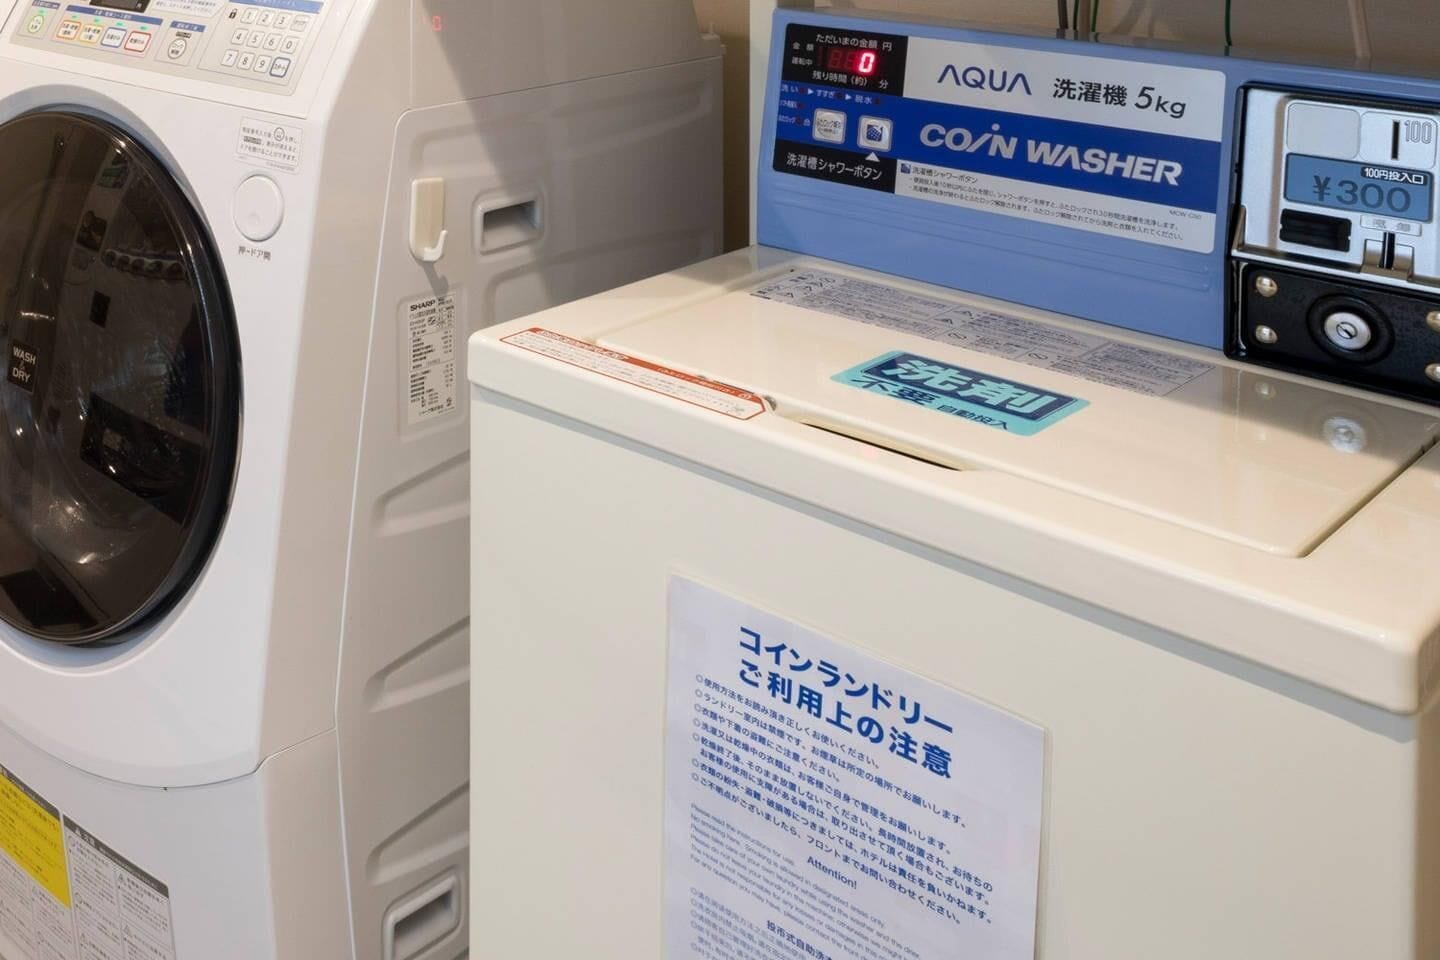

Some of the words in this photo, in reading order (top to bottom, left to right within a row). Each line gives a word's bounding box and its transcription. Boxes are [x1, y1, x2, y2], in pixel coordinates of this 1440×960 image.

[815, 34, 878, 49] ただいまの金額
[881, 41, 893, 52] 円
[858, 52, 875, 74] 0
[879, 79, 889, 89] 分
[937, 63, 1033, 96] AQUA
[1052, 77, 1128, 108] 洗濯機
[1134, 85, 1187, 119] 5kg
[1403, 119, 1433, 145] 100
[785, 152, 883, 180] 洗濯槽シャワーボタン
[912, 166, 979, 184] 洗濯槽シャワーボタン
[1026, 138, 1183, 187] WASHER
[1364, 167, 1425, 185] 100円投入口
[1312, 174, 1411, 214] ¥300
[410, 299, 436, 312] SHARP
[13, 345, 37, 366] WASH
[12, 367, 31, 383] DRY
[880, 359, 1058, 415] 洗剤
[850, 378, 942, 406] 不要
[936, 404, 1009, 431] 自動投入
[739, 626, 953, 735] コインランドリー
[738, 658, 952, 779] ご利用上の注意
[806, 855, 858, 890] Attention!
